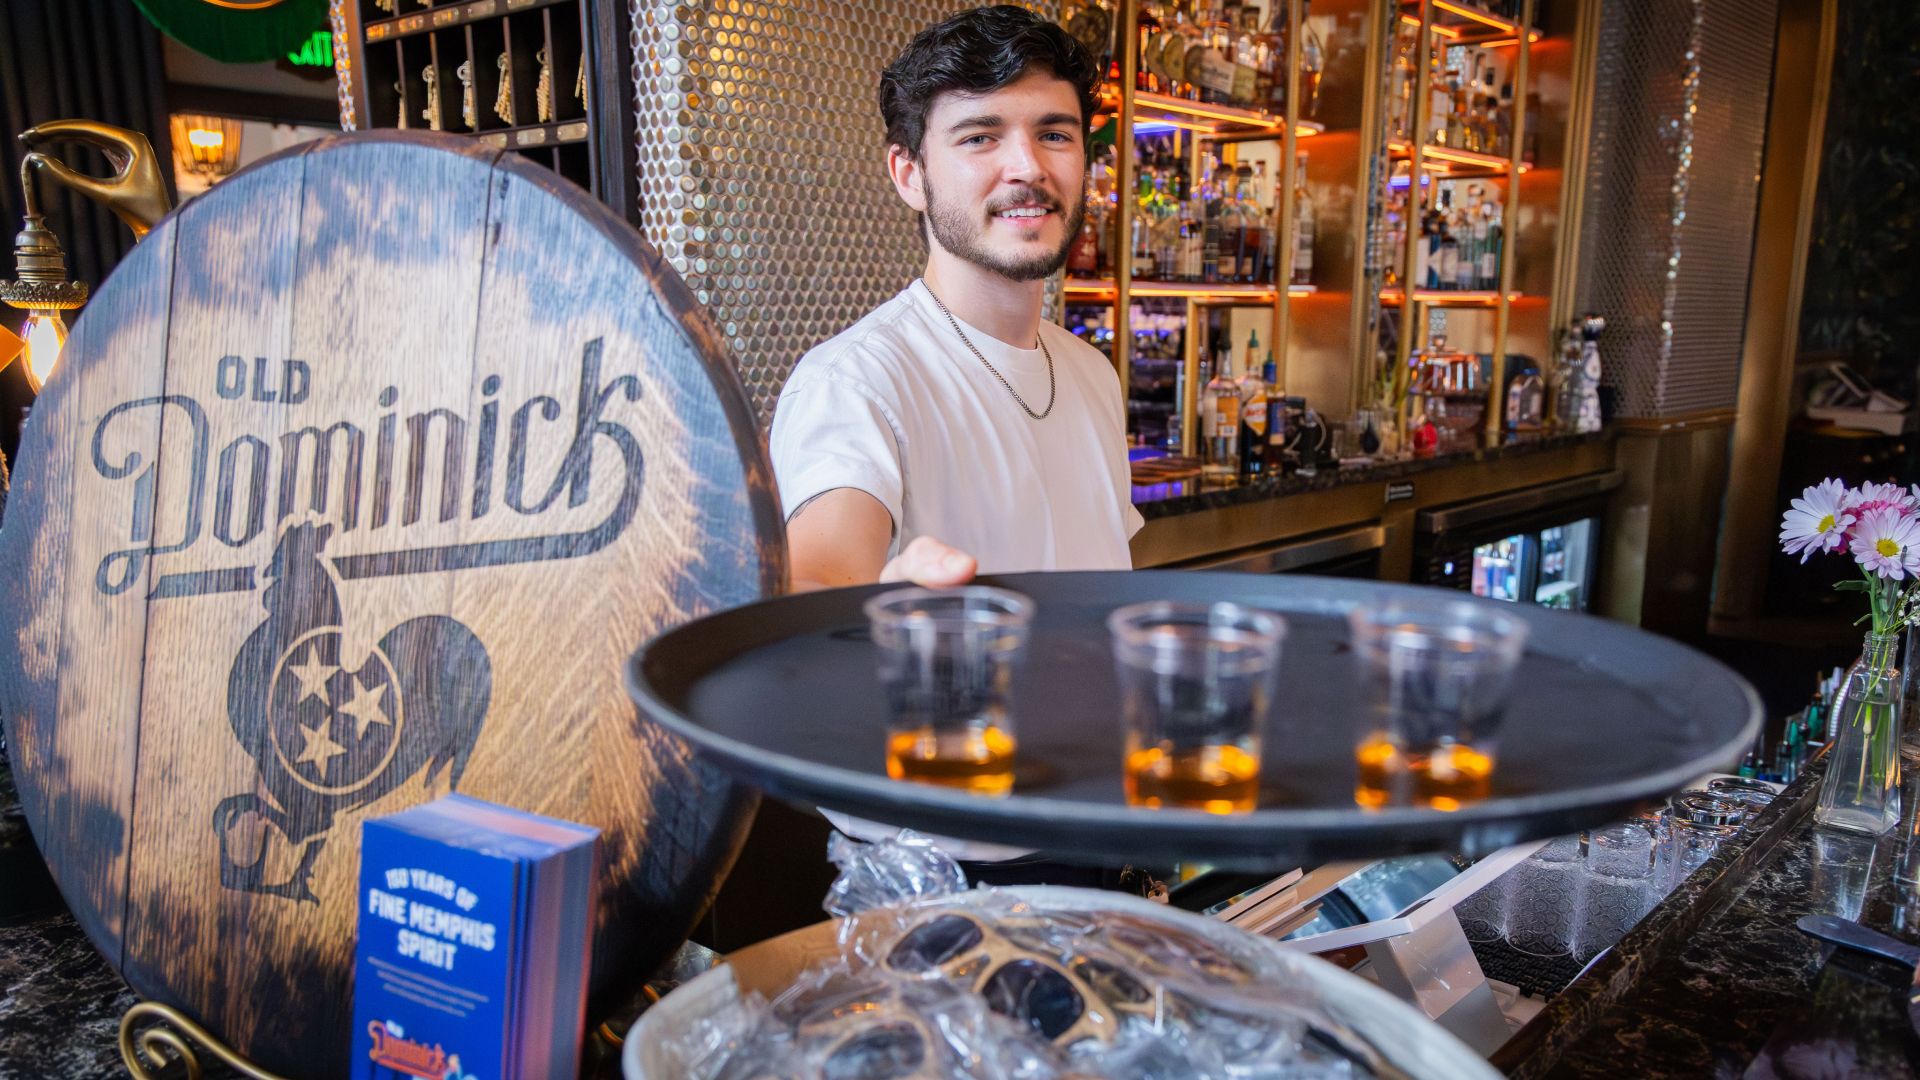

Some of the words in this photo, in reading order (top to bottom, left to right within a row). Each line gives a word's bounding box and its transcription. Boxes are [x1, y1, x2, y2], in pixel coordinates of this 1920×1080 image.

[216, 355, 311, 404] OLD
[91, 337, 646, 600] Dominick
[409, 868, 456, 900] YEARS
[369, 888, 407, 924] FINE
[409, 901, 496, 952] MEMPHIS
[397, 928, 457, 971] SPIRIT
